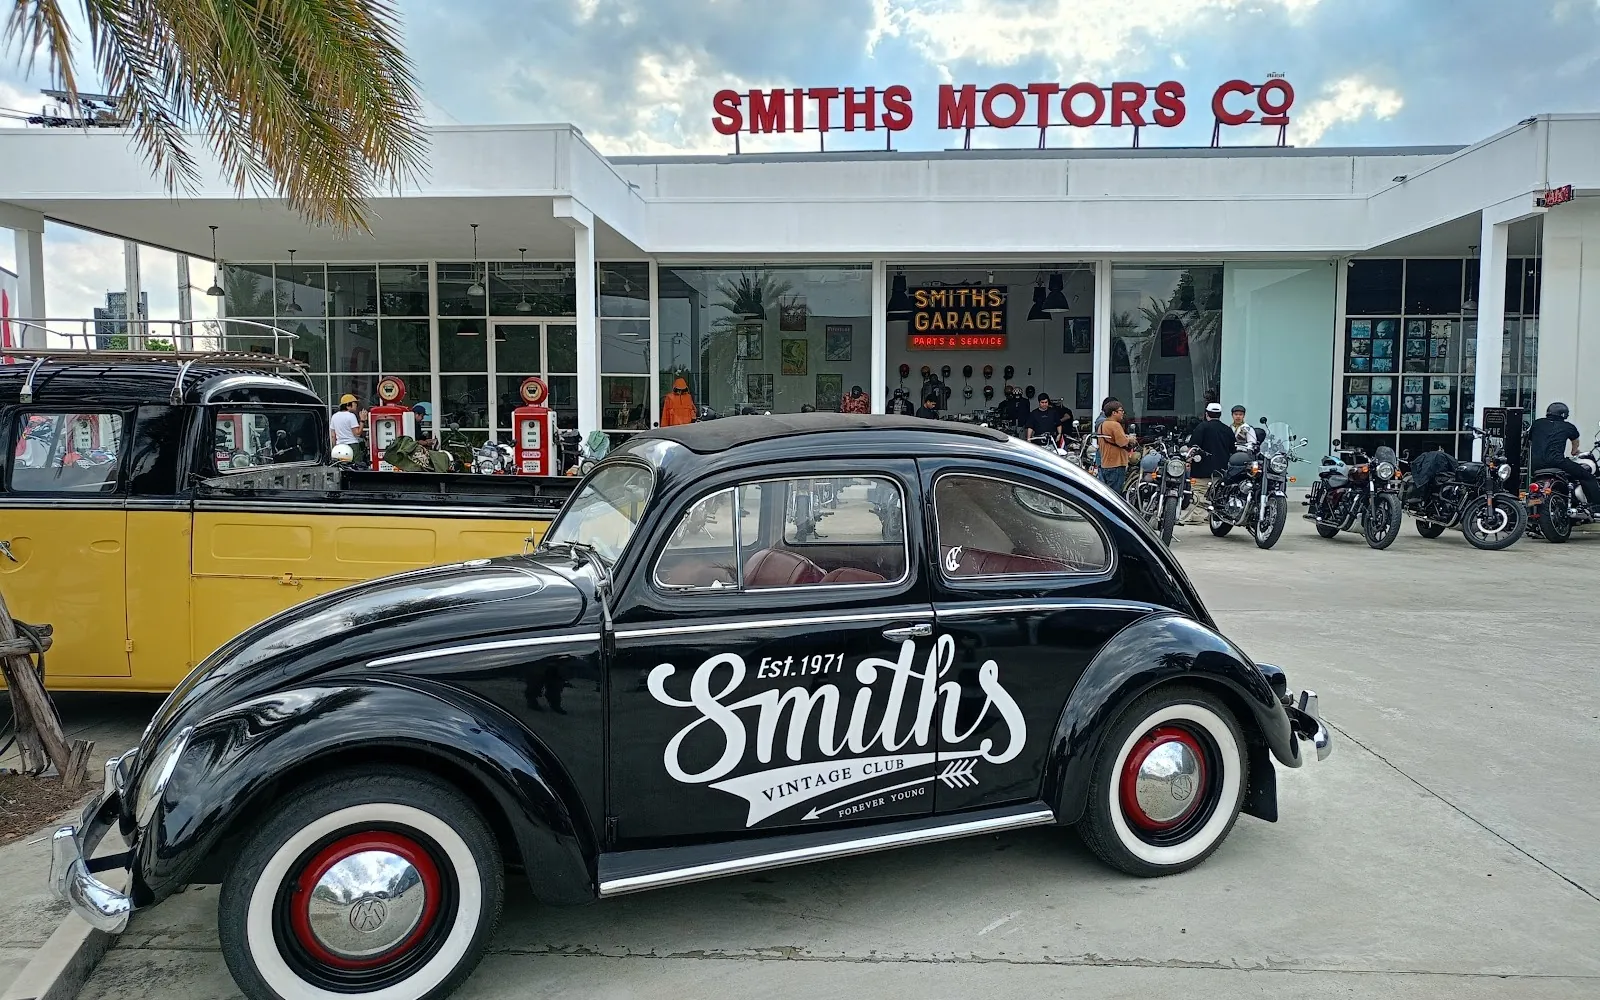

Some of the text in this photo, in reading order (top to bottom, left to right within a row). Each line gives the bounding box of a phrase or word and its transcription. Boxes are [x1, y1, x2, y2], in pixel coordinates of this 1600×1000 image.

[712, 85, 912, 135] SMITHS
[938, 81, 1186, 130] MOTORS
[914, 289, 1003, 309] SMITHS
[914, 310, 1003, 331] GARAGE
[914, 337, 1002, 346] PARTS & SERVICE
[647, 633, 1028, 784] Smiths
[762, 758, 906, 802] VINTAGE CLUB
[838, 787, 925, 818] FOREVER YOUNG
